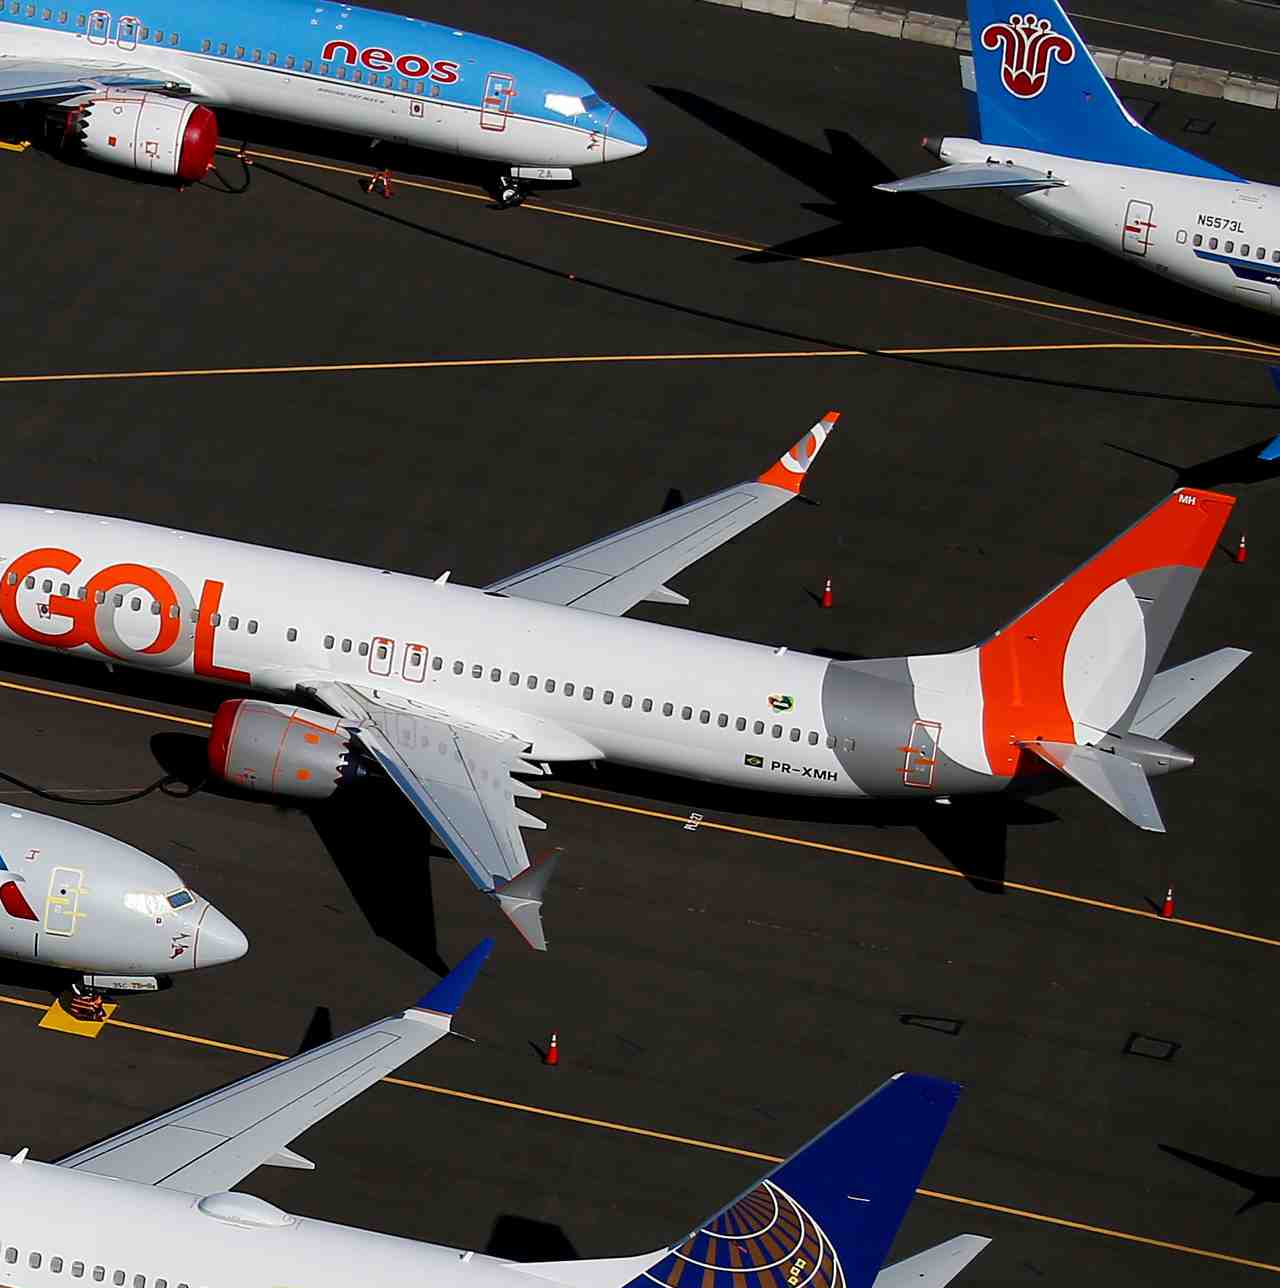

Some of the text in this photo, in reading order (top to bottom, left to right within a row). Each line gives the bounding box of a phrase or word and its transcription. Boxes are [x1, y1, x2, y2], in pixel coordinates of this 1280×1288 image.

[320, 39, 460, 85] neos
[1197, 213, 1245, 234] N5573L
[1178, 493, 1197, 506] MH
[770, 760, 839, 782] PR-XMH
